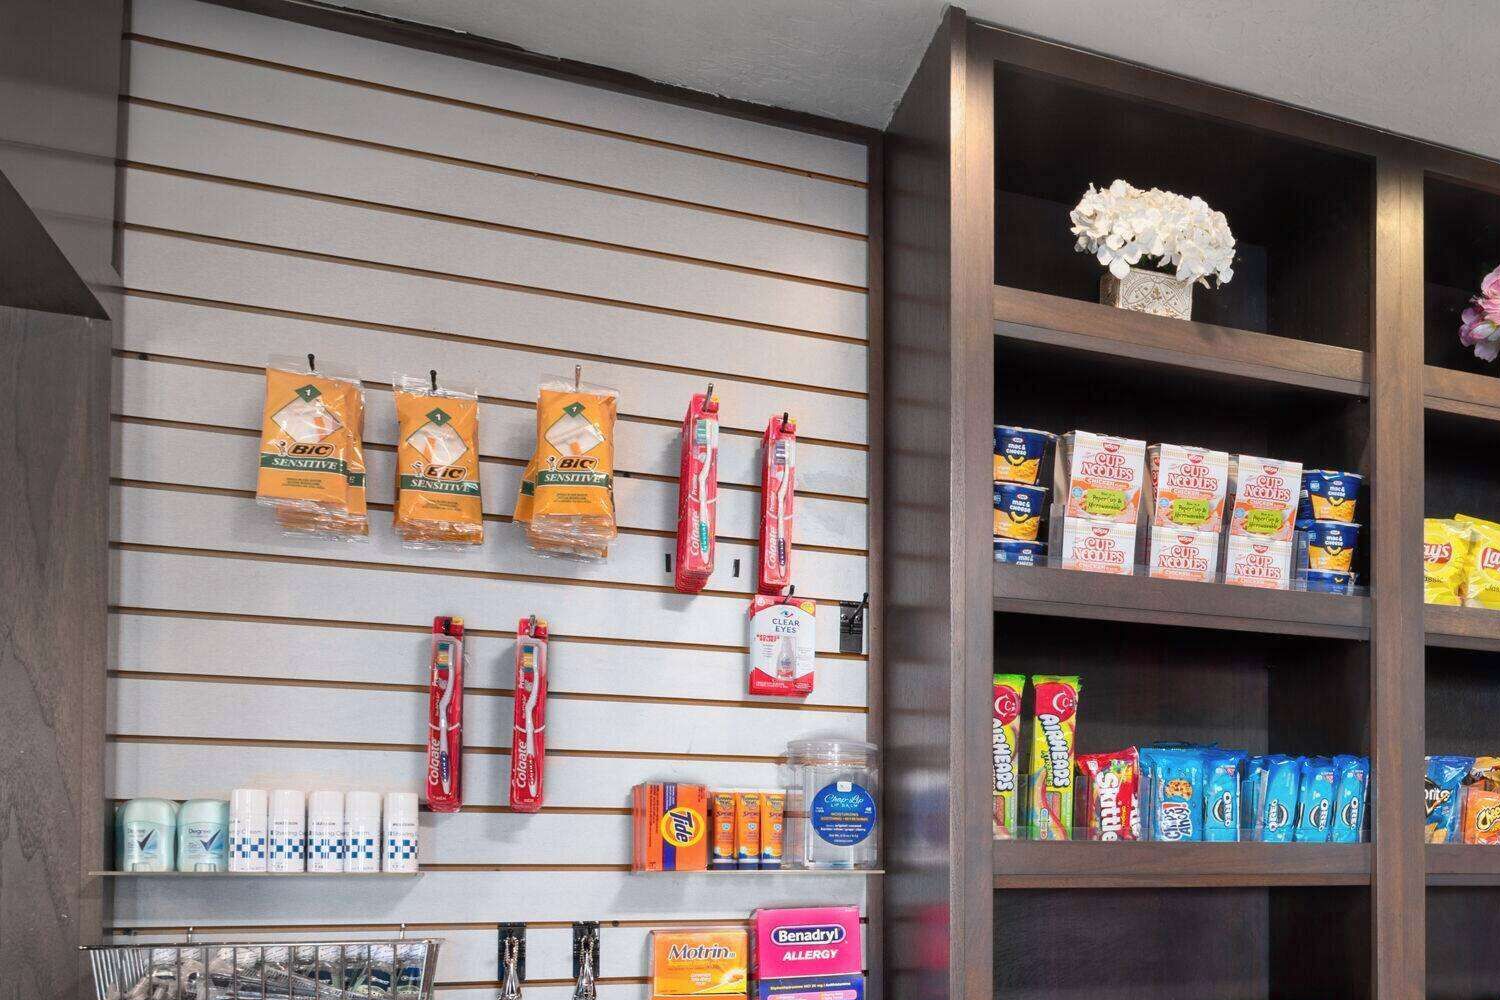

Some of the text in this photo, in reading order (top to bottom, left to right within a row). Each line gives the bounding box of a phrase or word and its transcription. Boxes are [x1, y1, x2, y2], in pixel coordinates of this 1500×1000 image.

[290, 443, 334, 457] BIC
[272, 457, 337, 471] SENSITIVE
[558, 457, 597, 471] BIC
[1094, 453, 1125, 467] CUP
[544, 472, 606, 484] SENSITIVE
[1081, 462, 1134, 481] NOODLES
[1180, 464, 1209, 477] CUP
[410, 478, 471, 493] SENSITIVE
[1167, 473, 1218, 490] NOODLES
[1257, 476, 1283, 487] CUP
[1243, 486, 1291, 501] NOODLES
[689, 510, 701, 556] Colgate
[767, 526, 777, 570] Colgate
[1084, 537, 1115, 550] CUP
[1072, 546, 1124, 564] NOODLES
[1171, 546, 1199, 558] CUP
[1159, 555, 1208, 571] NOODLES
[1245, 555, 1273, 566] CUP
[1234, 564, 1281, 579] NOODLES
[772, 618, 800, 626] CLEAR
[775, 625, 797, 634] EYES
[1039, 714, 1070, 787] AIRHEADS
[428, 739, 441, 785] Colgate
[516, 741, 528, 788] Colgate
[1223, 791, 1232, 827] OREO
[1268, 800, 1279, 832] OREO
[1318, 799, 1329, 832] OREO
[1350, 797, 1359, 830] OREO
[669, 809, 692, 844] Tide
[1165, 809, 1181, 839] Chips
[778, 928, 840, 945] Benadryl
[668, 943, 729, 960] Motrin
[782, 948, 838, 962] ALLERGY
